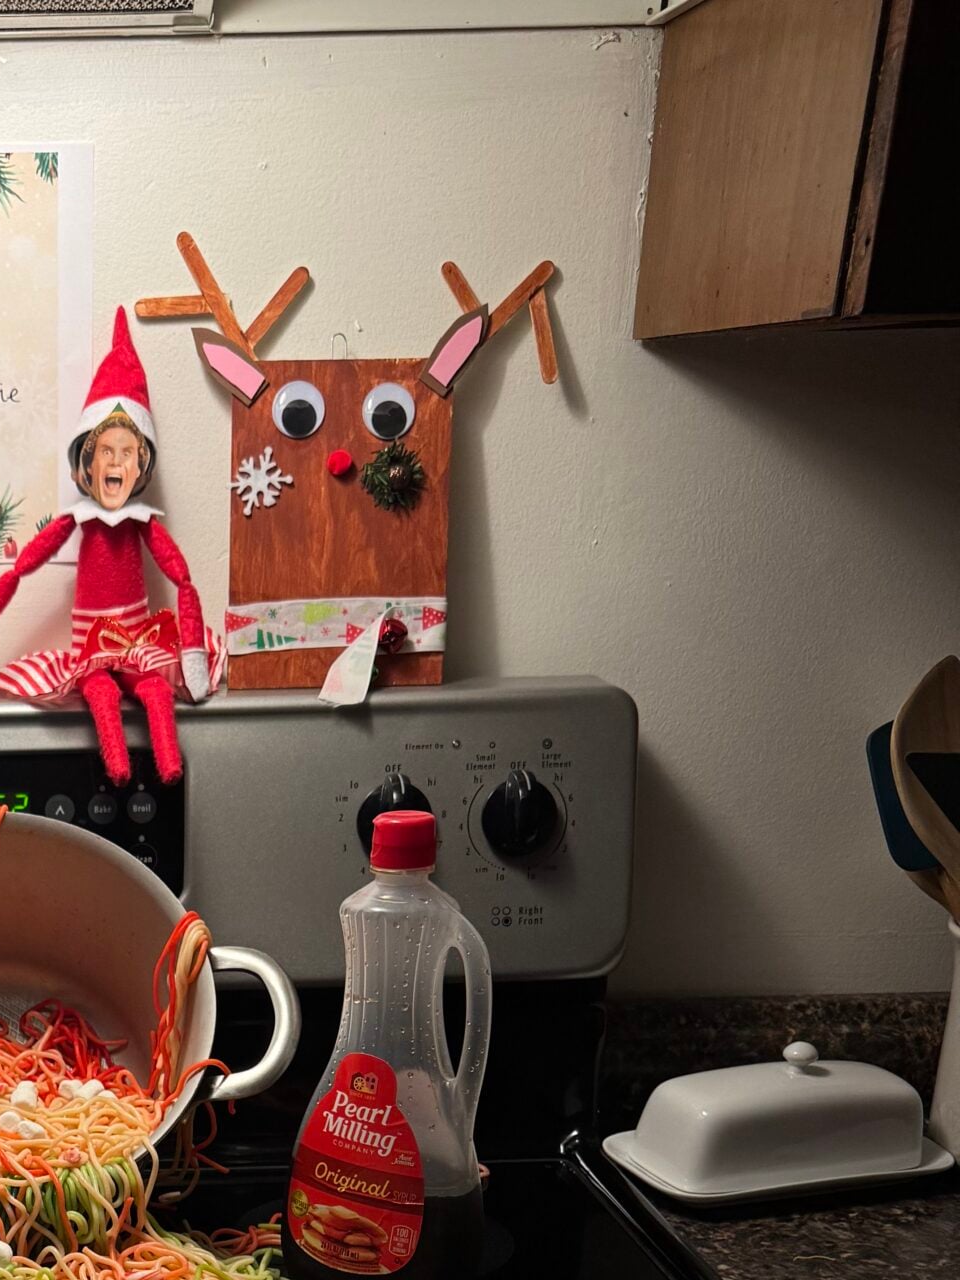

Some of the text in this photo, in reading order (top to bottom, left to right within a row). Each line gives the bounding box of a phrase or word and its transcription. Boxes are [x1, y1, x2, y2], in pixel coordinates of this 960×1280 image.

[475, 753, 496, 762] Small
[541, 752, 562, 762] Large
[384, 764, 402, 773] OFF
[465, 762, 496, 771] Element
[510, 761, 527, 770] OFF
[541, 760, 572, 769] Element
[473, 774, 483, 784] hi
[554, 772, 564, 782] hi
[349, 780, 359, 789] lo
[93, 804, 112, 814] Bake
[132, 803, 152, 813] Broil
[337, 813, 345, 823] 2
[496, 871, 505, 881] lo
[518, 906, 543, 916] Right
[518, 916, 543, 925] Front
[331, 1089, 392, 1126] Pearl
[322, 1110, 398, 1157] Milling
[332, 1138, 376, 1156] COMPANY
[314, 1161, 391, 1199] Original
